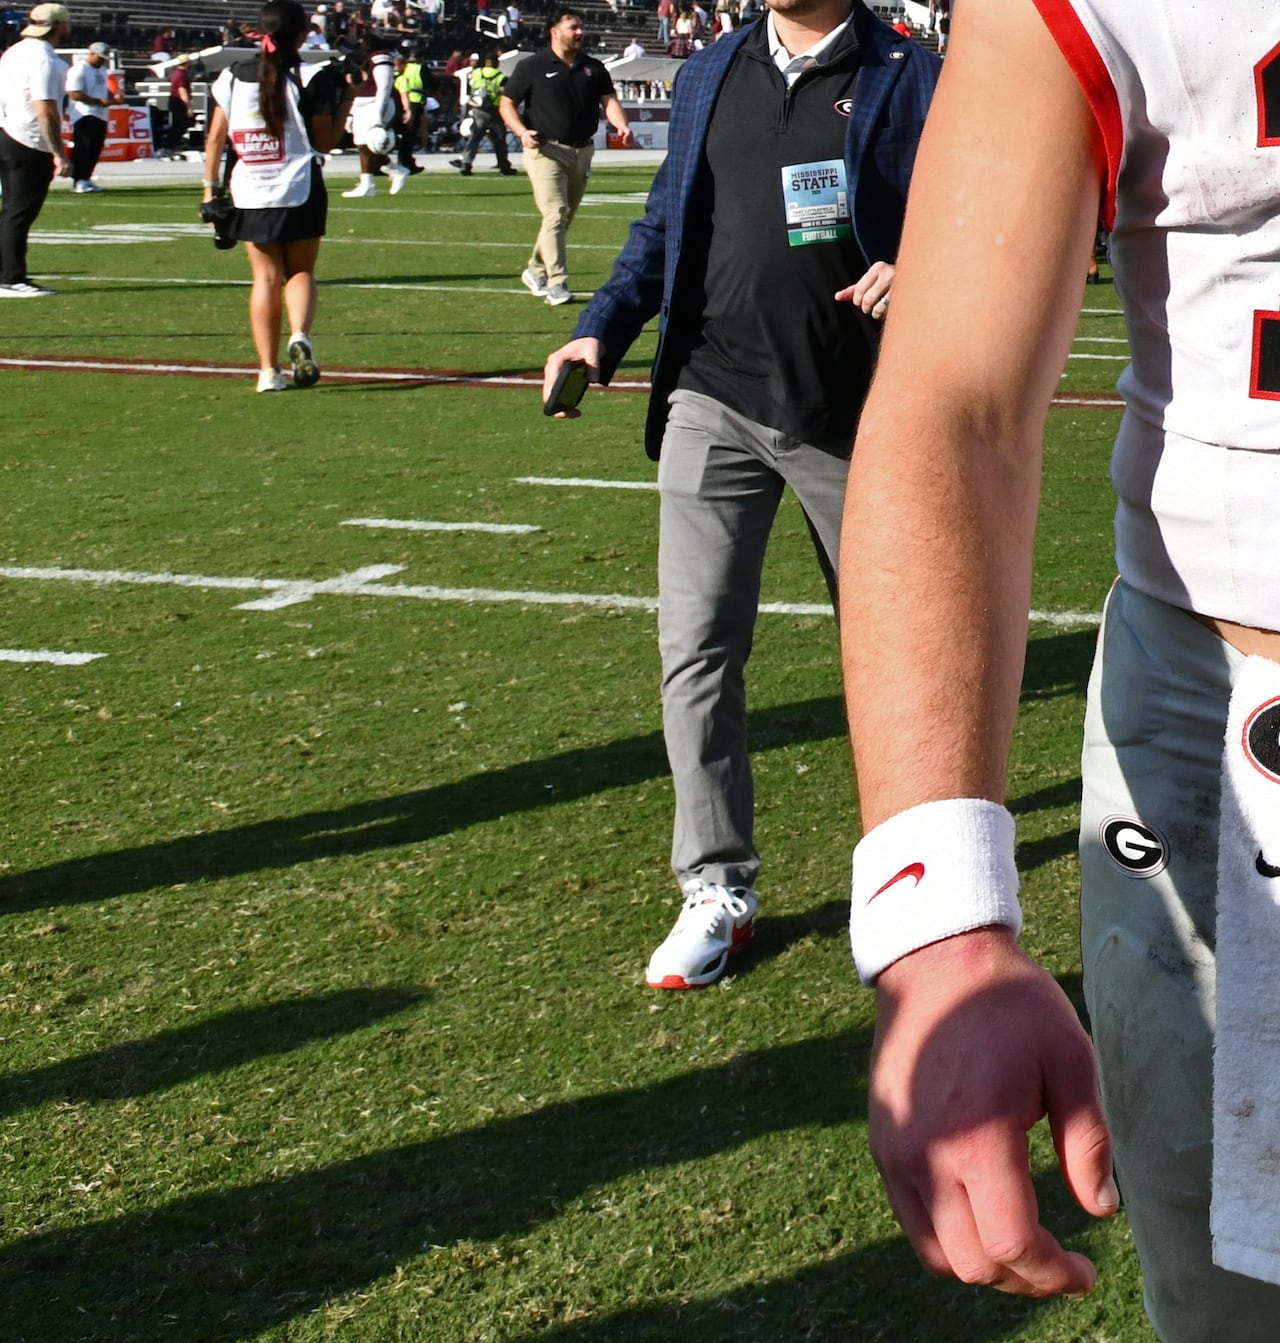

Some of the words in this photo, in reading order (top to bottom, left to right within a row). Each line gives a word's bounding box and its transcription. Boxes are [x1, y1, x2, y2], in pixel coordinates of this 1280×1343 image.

[792, 168, 837, 179] MISSISSIPPI
[792, 175, 839, 191] STATE
[802, 229, 838, 242] FOOTBALL
[1103, 819, 1167, 872] G
